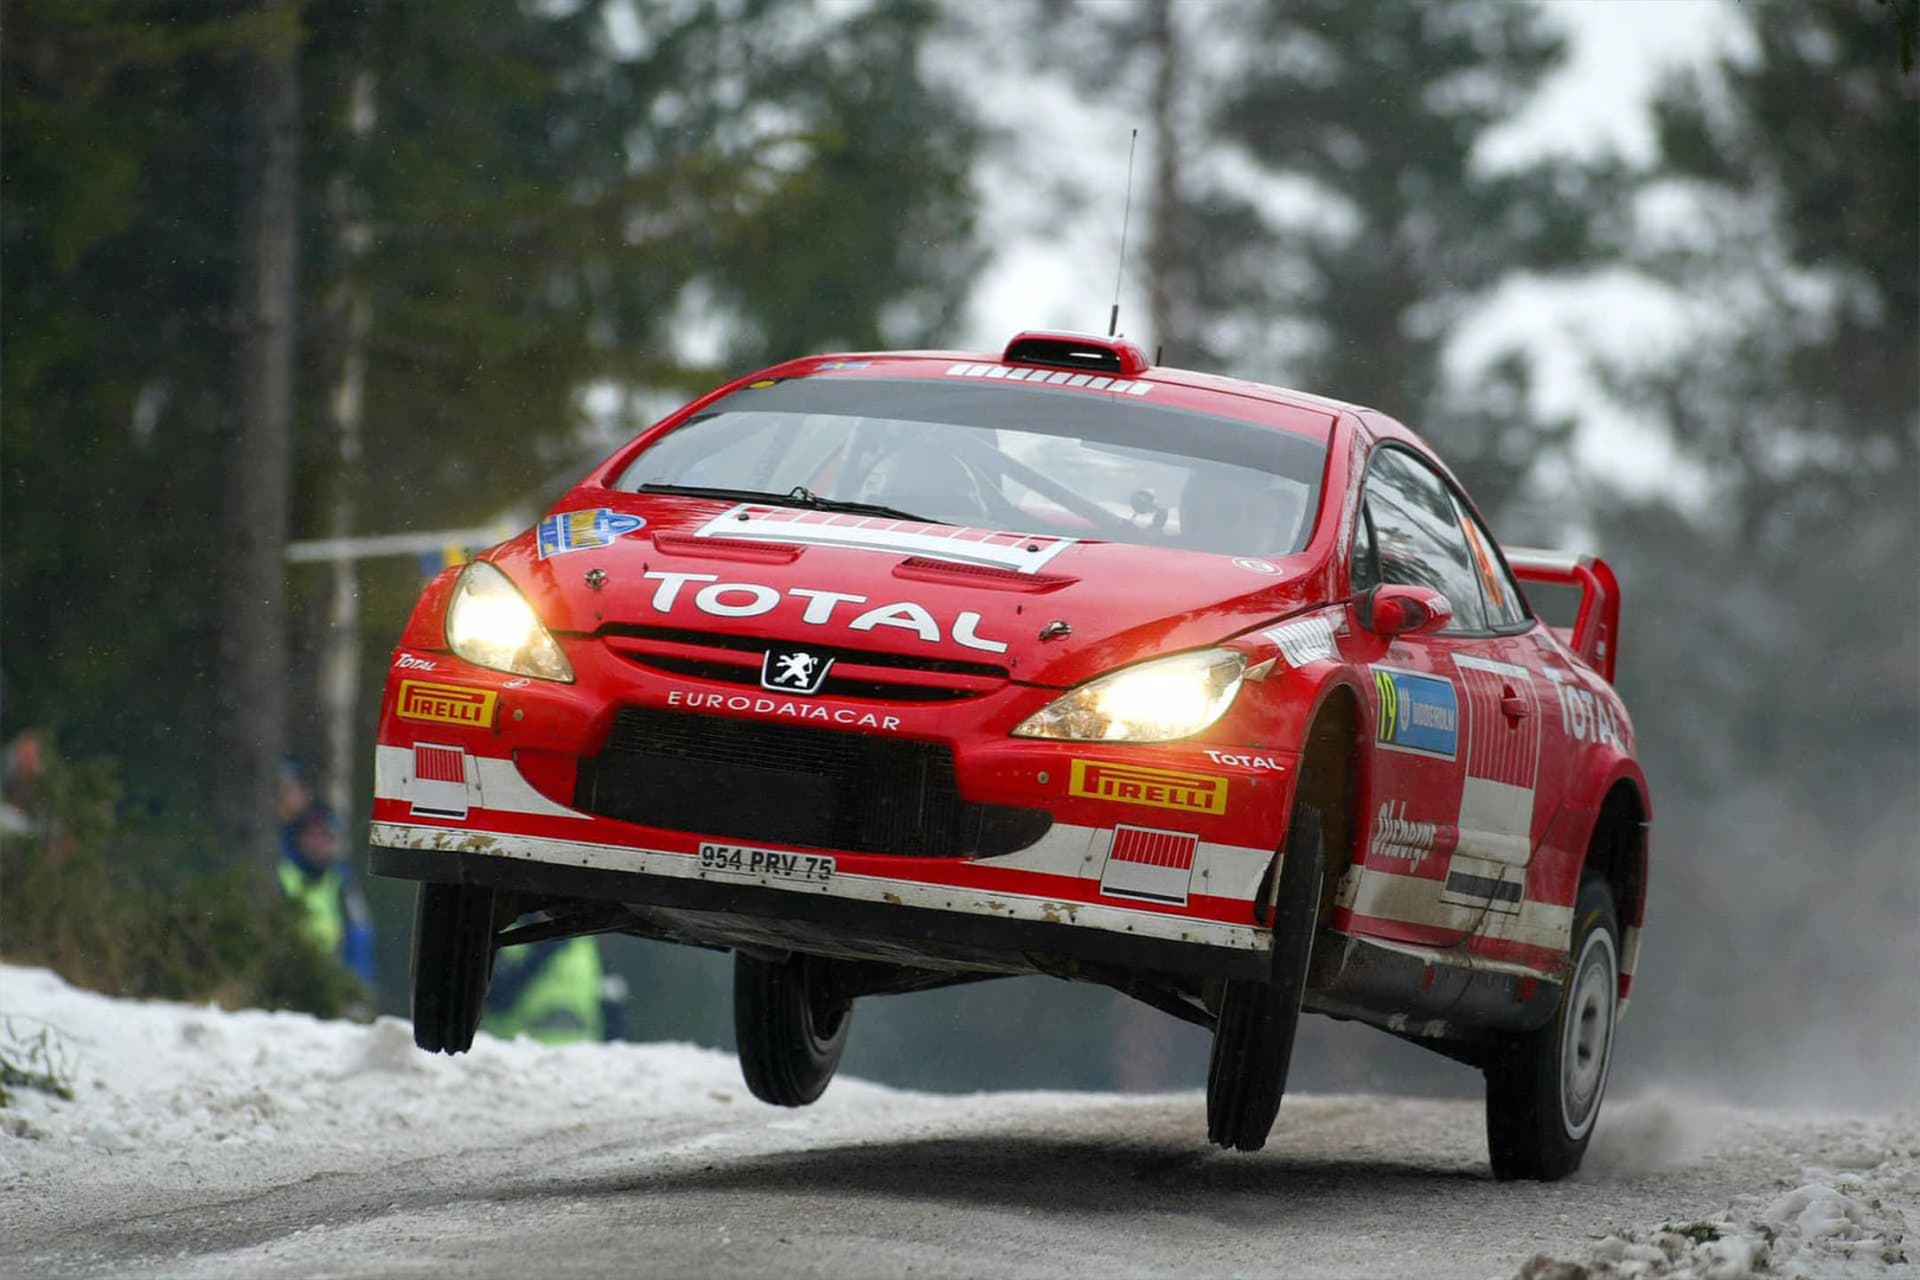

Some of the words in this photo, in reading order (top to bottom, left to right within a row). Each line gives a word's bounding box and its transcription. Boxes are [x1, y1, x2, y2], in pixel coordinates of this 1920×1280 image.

[643, 570, 1009, 654] TOTAL
[394, 652, 438, 671] TOTAL
[403, 684, 486, 722] PIRELLI
[667, 690, 901, 731] EURODATACAR
[1374, 669, 1397, 742] 19
[1541, 665, 1629, 755] TOTAL
[1202, 749, 1286, 771] TOTAL
[1082, 764, 1217, 809] PIRELLI
[701, 845, 743, 871] 954
[750, 851, 798, 877] PRV
[804, 857, 834, 881] 75
